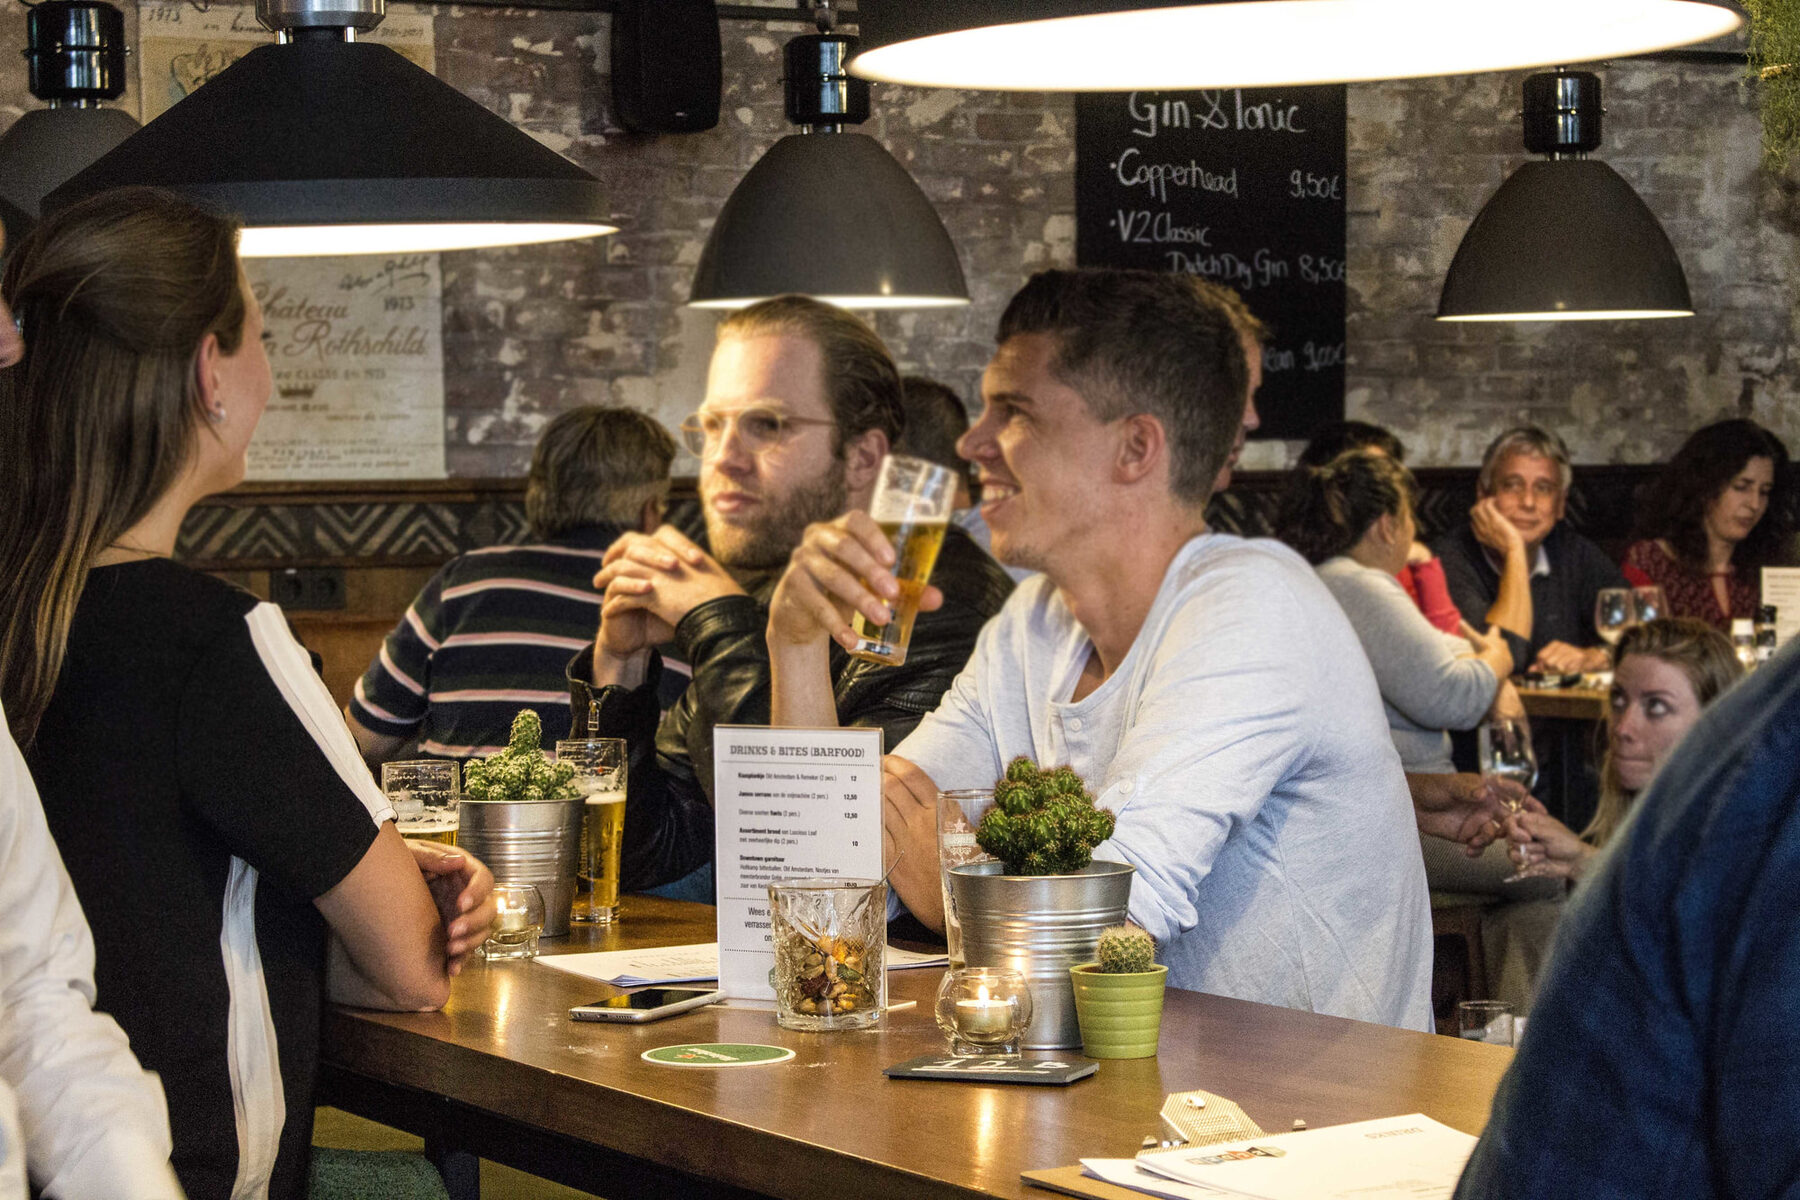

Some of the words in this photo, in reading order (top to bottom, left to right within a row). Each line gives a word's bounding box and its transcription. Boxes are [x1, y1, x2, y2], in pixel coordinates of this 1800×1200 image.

[1129, 90, 1191, 138] Gin
[1116, 147, 1239, 203] Copperhead
[1255, 248, 1288, 286] Gin
[283, 319, 430, 363] Rothschild
[730, 745, 768, 756] DRINKS
[778, 746, 809, 757] BITES
[810, 747, 865, 759] (BARFOOD)
[843, 793, 858, 801] 12,50
[748, 906, 765, 917] Wees
